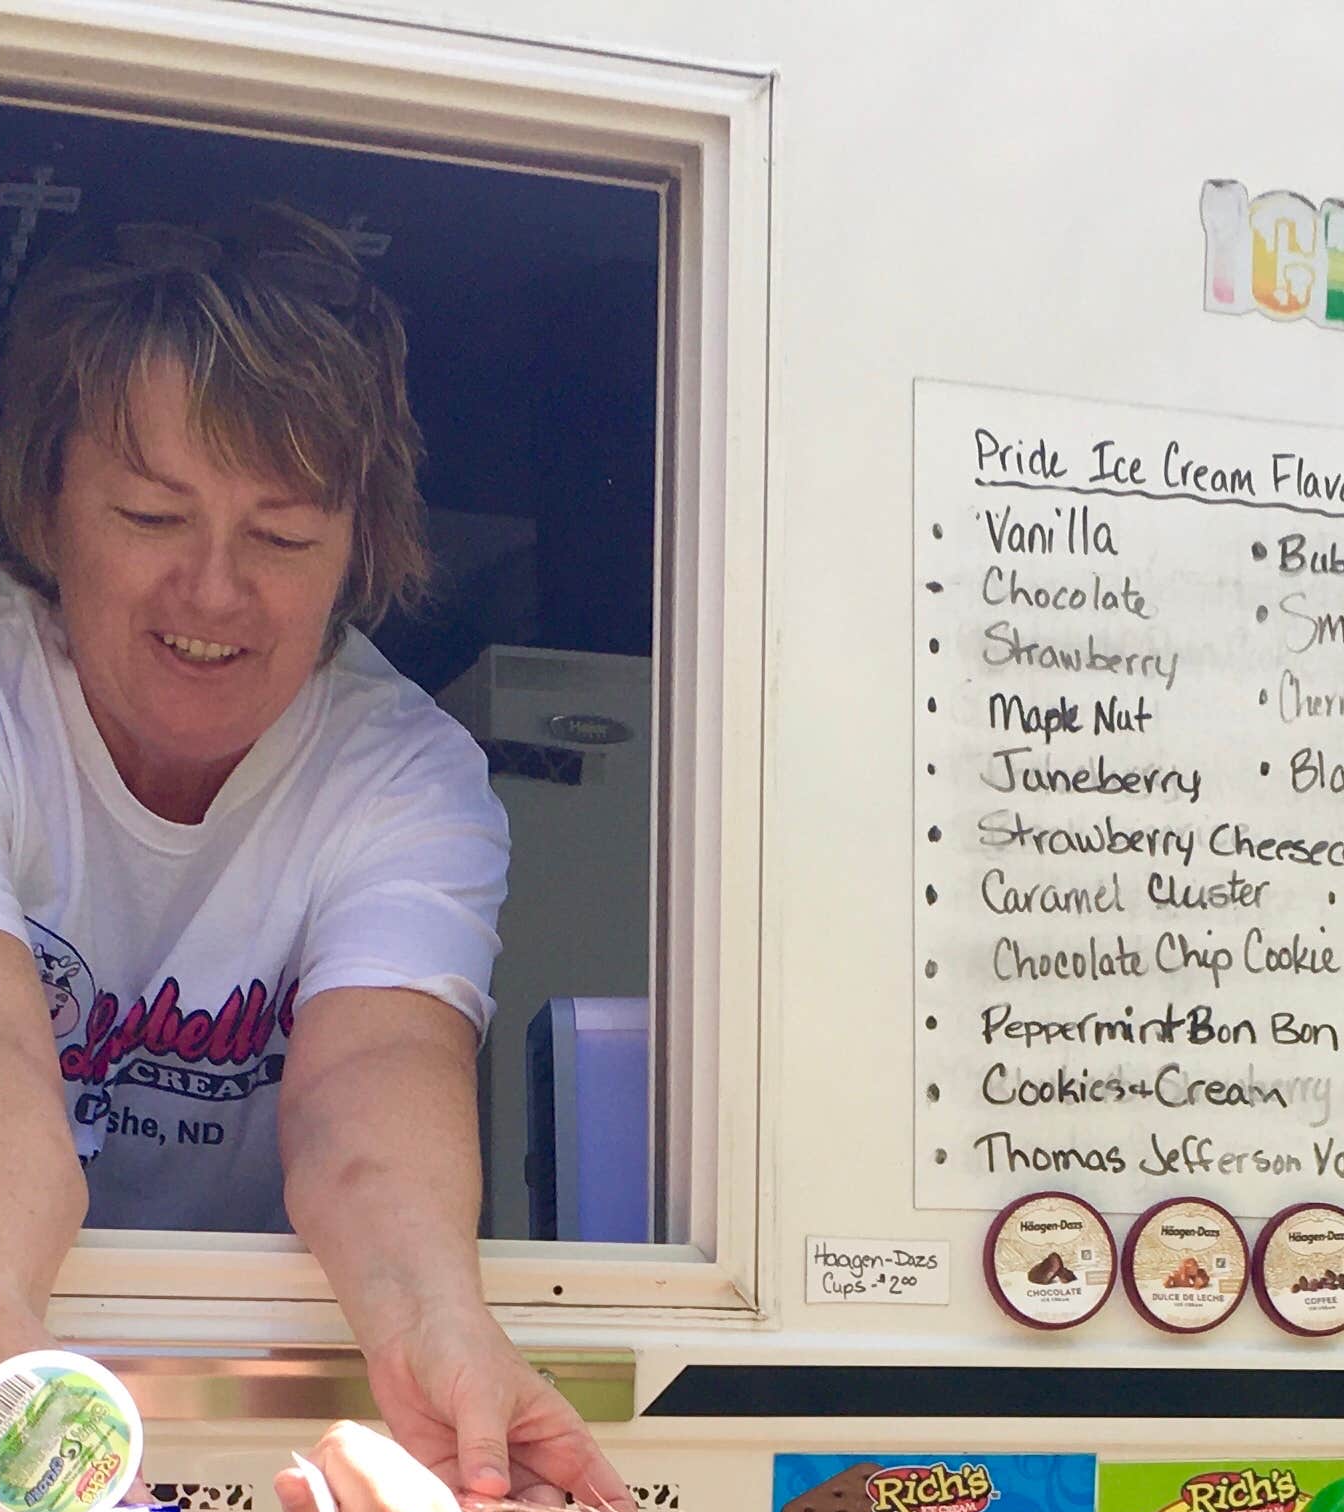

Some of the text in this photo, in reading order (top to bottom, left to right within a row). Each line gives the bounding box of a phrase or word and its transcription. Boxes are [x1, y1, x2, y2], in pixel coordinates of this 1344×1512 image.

[975, 428, 1068, 479] Pride
[1089, 440, 1147, 485] Ice
[1161, 440, 1255, 496] Cream
[985, 506, 1118, 556] Vanilla
[982, 566, 1149, 621] Chocolate
[982, 623, 1179, 690] Strawberry
[989, 693, 1153, 743] Maple Nut
[981, 747, 1202, 801] Juneberry
[977, 808, 1195, 862] Strawberry
[981, 869, 1271, 917] Caramel Cluster
[993, 930, 1149, 982] Chocolate
[1156, 928, 1233, 988] Chip
[1244, 929, 1340, 975] Cookie
[982, 1003, 1340, 1051] Peppermint Bon Bon
[1155, 1064, 1288, 1108] Cream
[178, 1119, 225, 1146] ND
[974, 1131, 1126, 1175] Thomas
[1139, 1130, 1302, 1182] Jefferson
[1020, 1219, 1083, 1234] Häagen-Dazs
[1160, 1225, 1220, 1239] Häagen-Dazs
[822, 1271, 867, 1300] Cups
[1027, 1287, 1082, 1297] CHOCOLATE
[1152, 1293, 1225, 1302] DULCE DE LECHE
[1304, 1296, 1338, 1305] COFFEE
